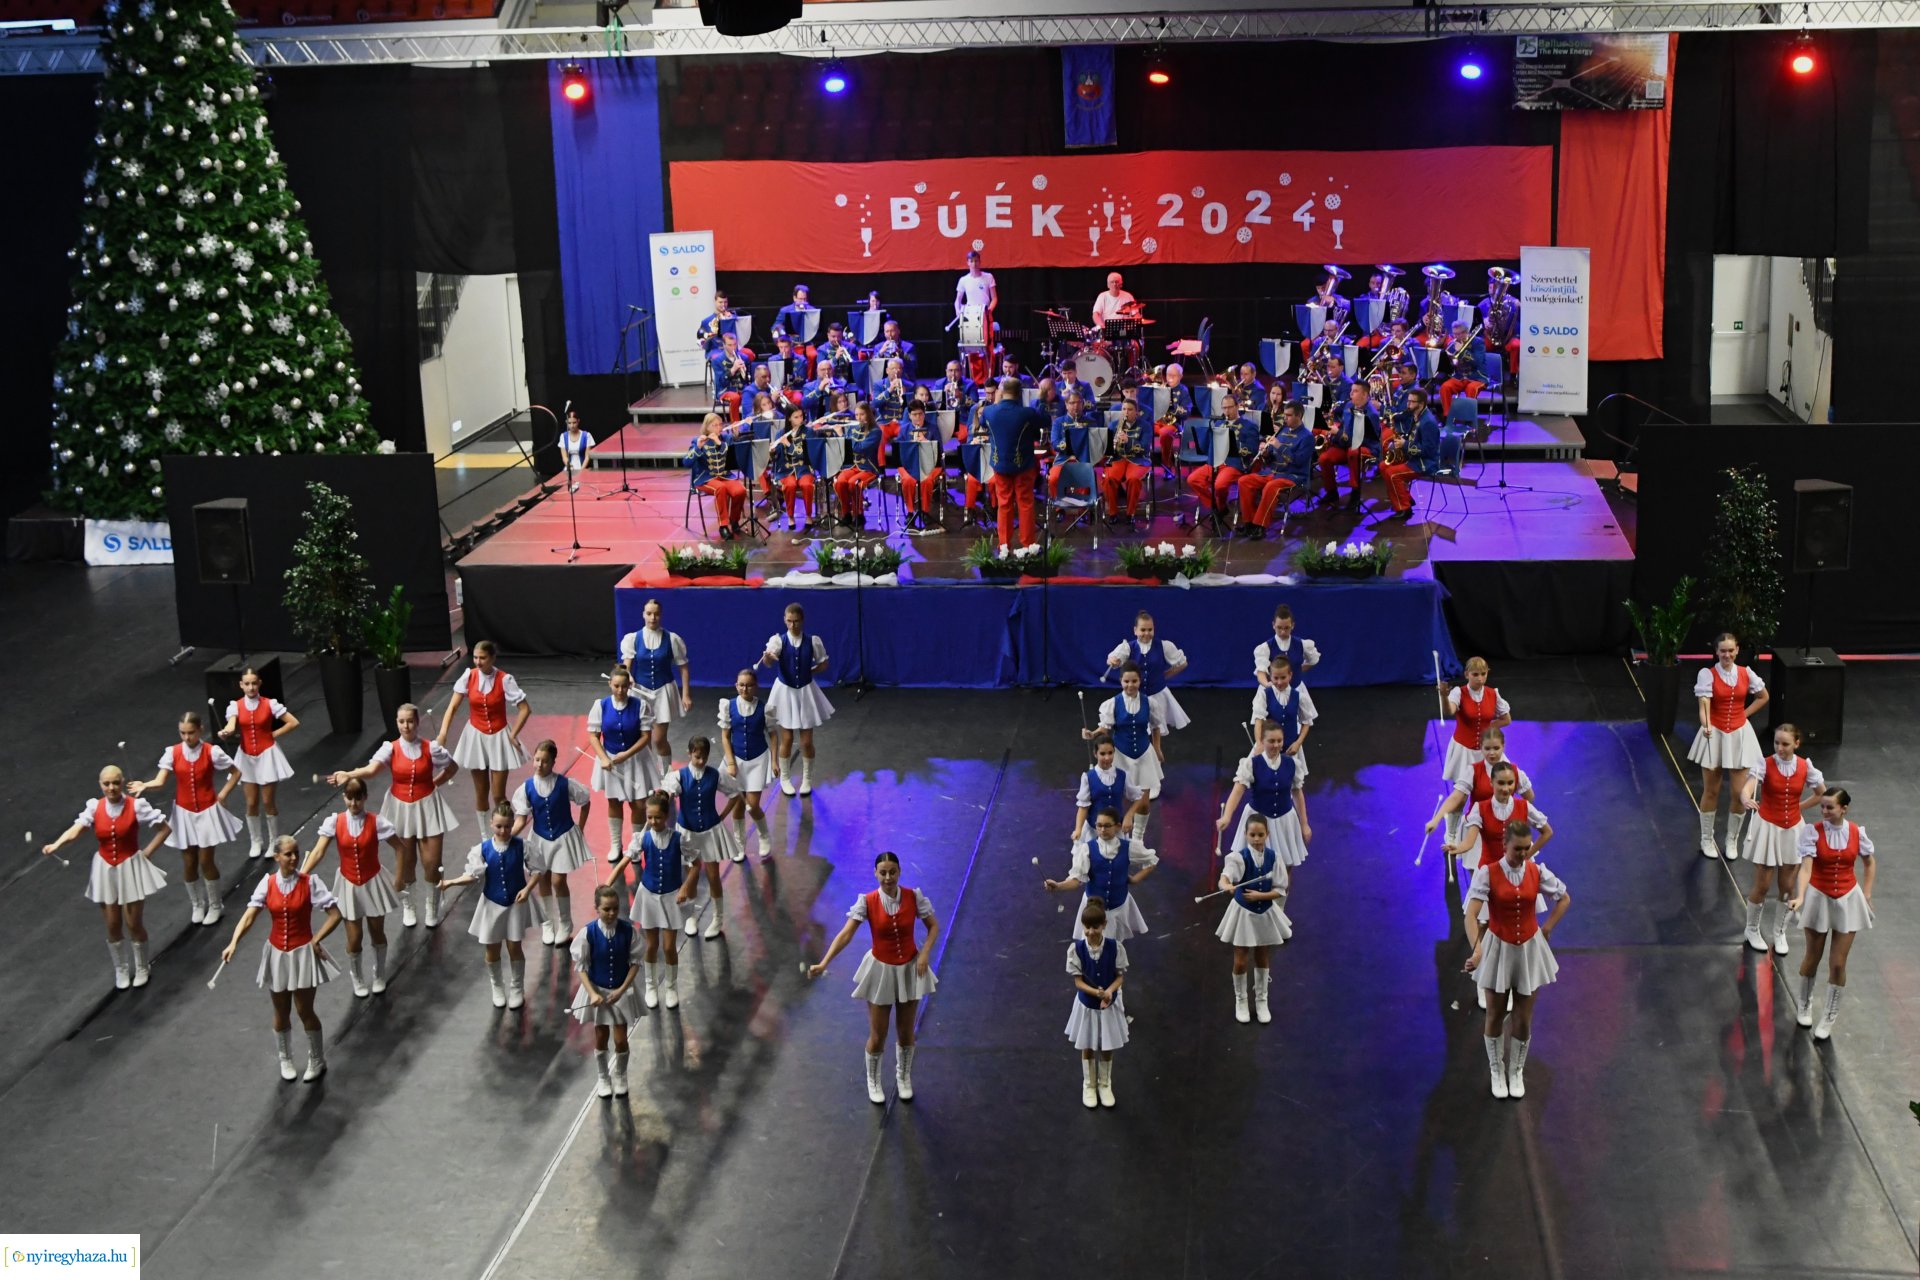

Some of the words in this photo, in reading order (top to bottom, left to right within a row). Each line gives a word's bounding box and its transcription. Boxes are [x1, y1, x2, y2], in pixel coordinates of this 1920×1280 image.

[1569, 48, 1594, 56] Energy
[889, 181, 1065, 239] BÚÉK
[1156, 188, 1316, 235] 2024
[672, 244, 705, 254] SALDO
[1530, 275, 1578, 284] Szeretettel
[1530, 284, 1578, 295] köszöntjük
[1524, 294, 1584, 304] vendégeinket!
[1543, 326, 1579, 336] SALDO
